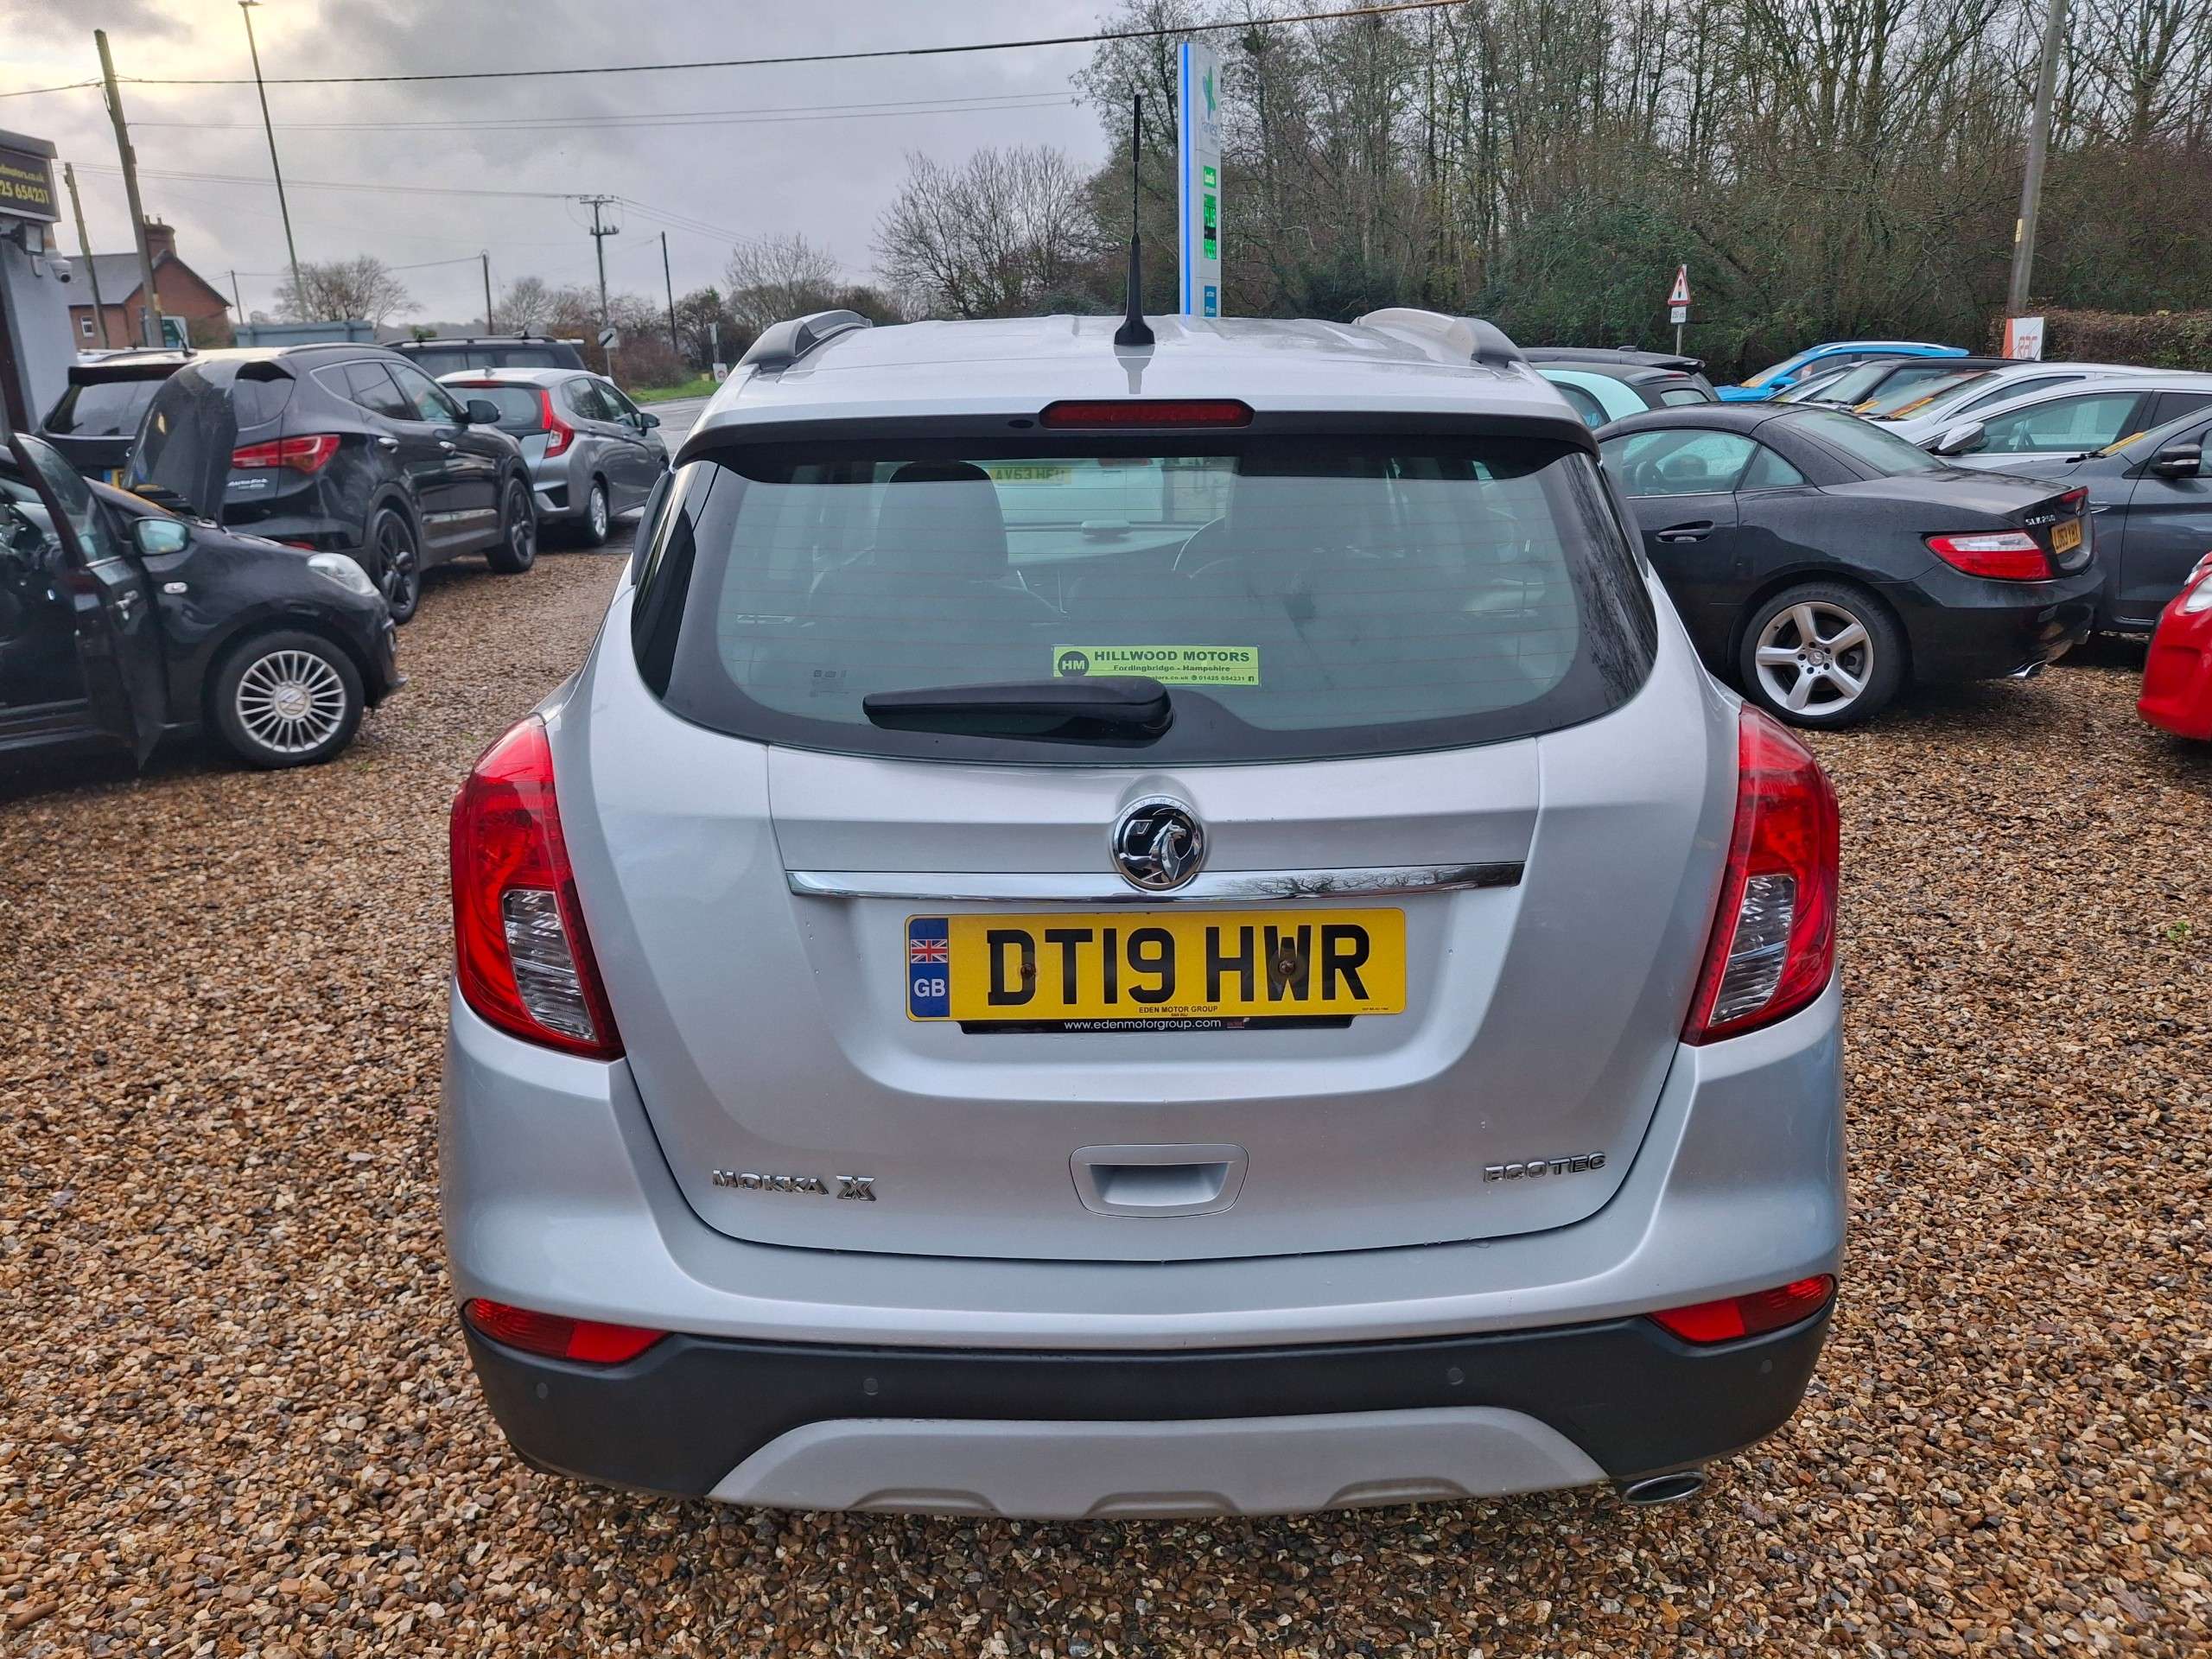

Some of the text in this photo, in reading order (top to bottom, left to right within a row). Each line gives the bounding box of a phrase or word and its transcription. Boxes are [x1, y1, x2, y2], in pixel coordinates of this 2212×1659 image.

[1062, 660, 1085, 671] HM
[1094, 651, 1250, 663] HILLWOOD MOTORS
[1113, 664, 1174, 673] Fordingbridge
[1183, 664, 1230, 673] Hampshire
[987, 924, 1370, 1005] DT19 HWR
[913, 978, 946, 998] GB
[1064, 1018, 1222, 1032] www.edenmotorgroup.com
[1484, 1151, 1606, 1183] ECOTEC
[712, 1169, 830, 1196] MOKKA
